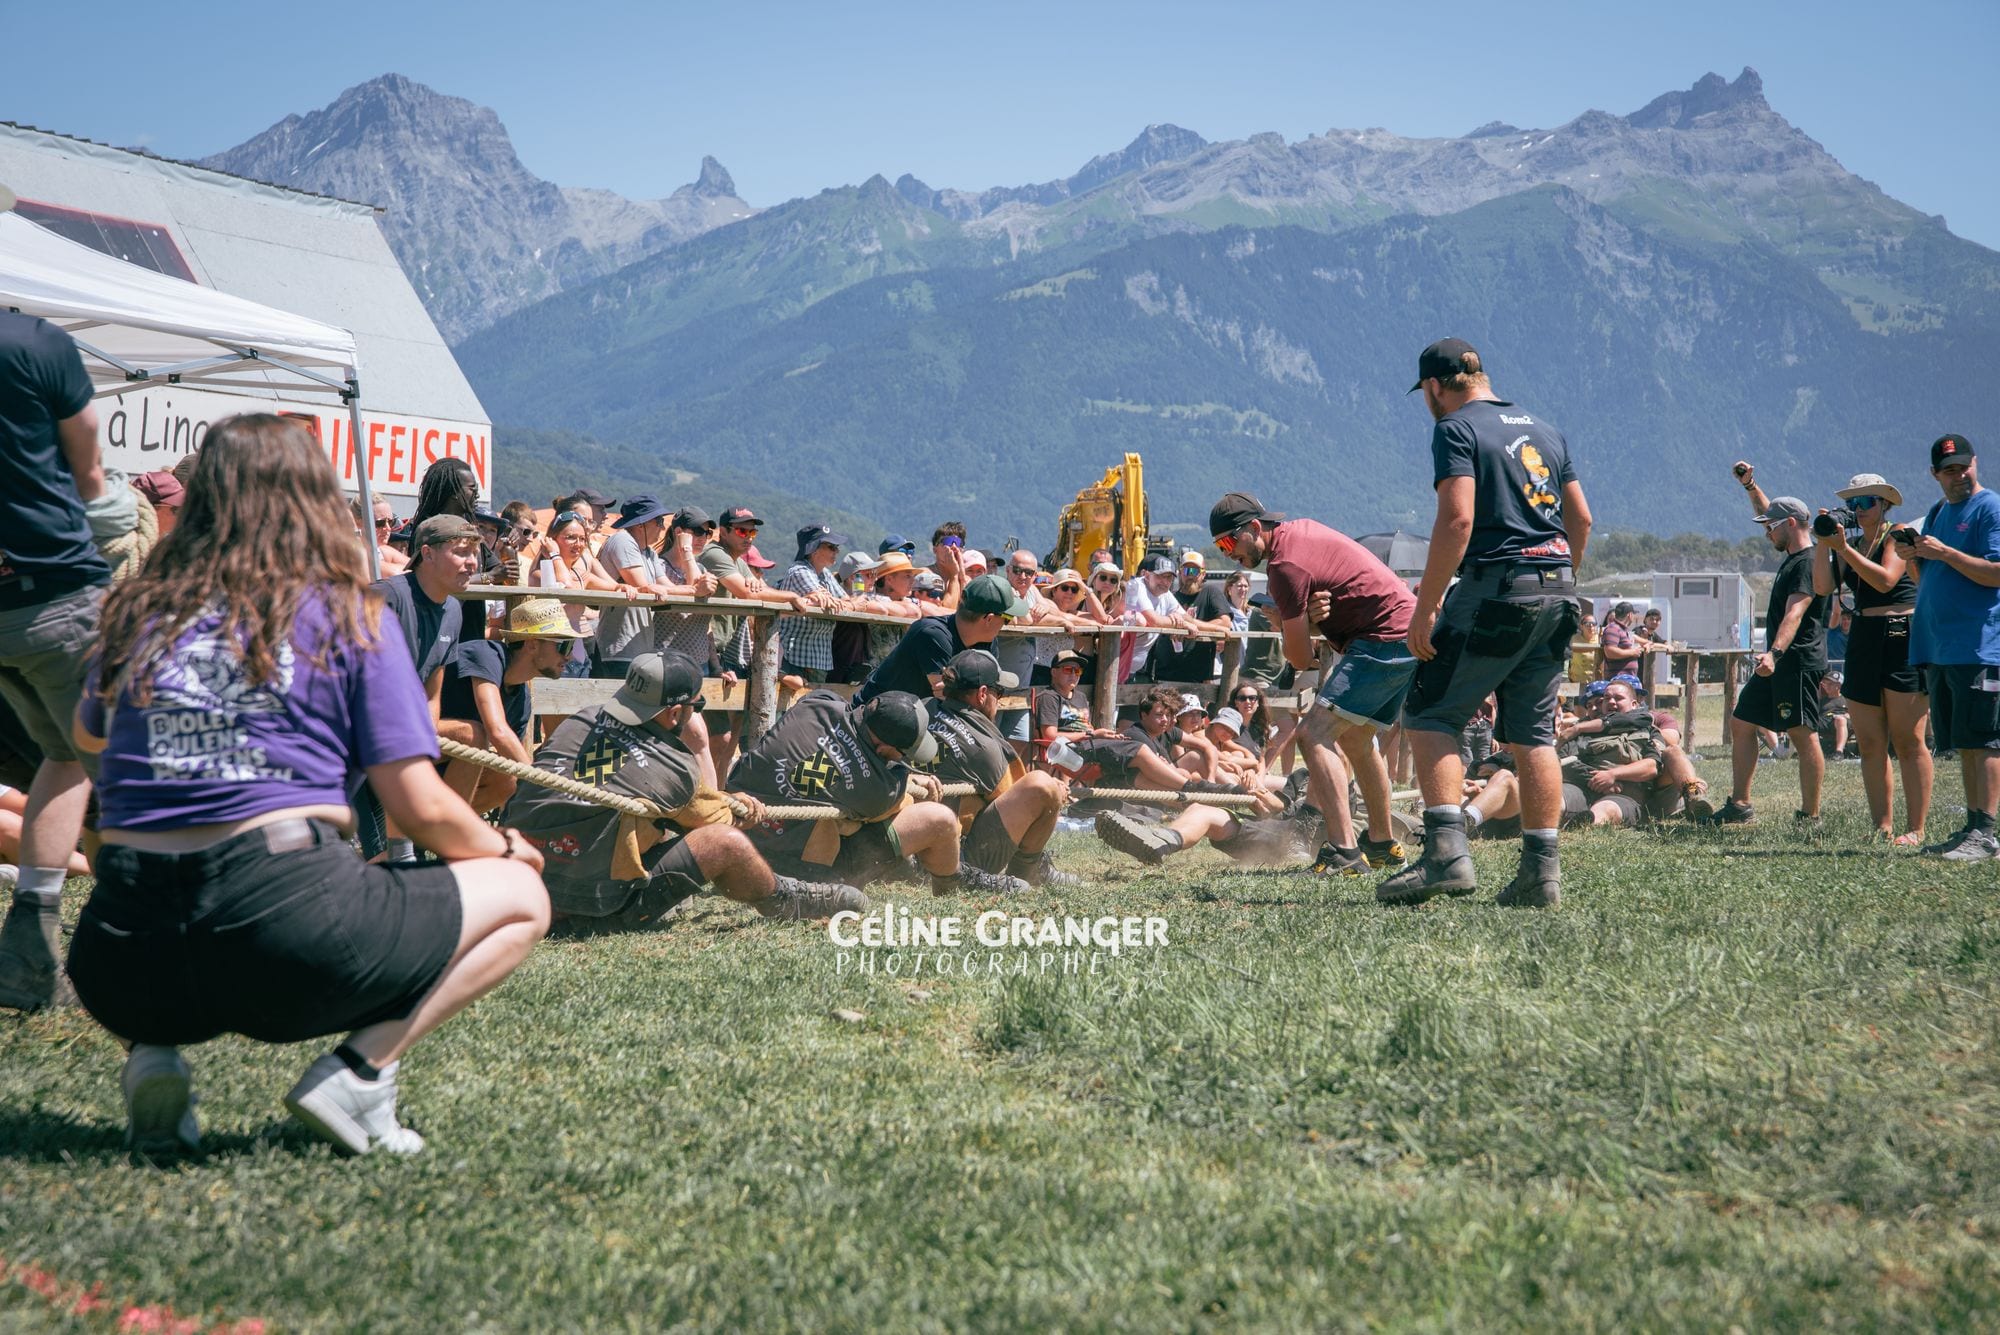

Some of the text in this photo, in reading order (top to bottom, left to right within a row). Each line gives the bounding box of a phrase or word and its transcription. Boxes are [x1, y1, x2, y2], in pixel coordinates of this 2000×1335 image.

[108, 394, 127, 449] à
[1499, 414, 1534, 425] Rom2
[147, 711, 238, 736] BIOLEY
[927, 720, 963, 759] d'Oulens
[934, 710, 976, 746] Jeunesse
[147, 730, 249, 758] OULENS
[817, 735, 855, 790] d'Oulens
[830, 722, 871, 778] Jeunesse
